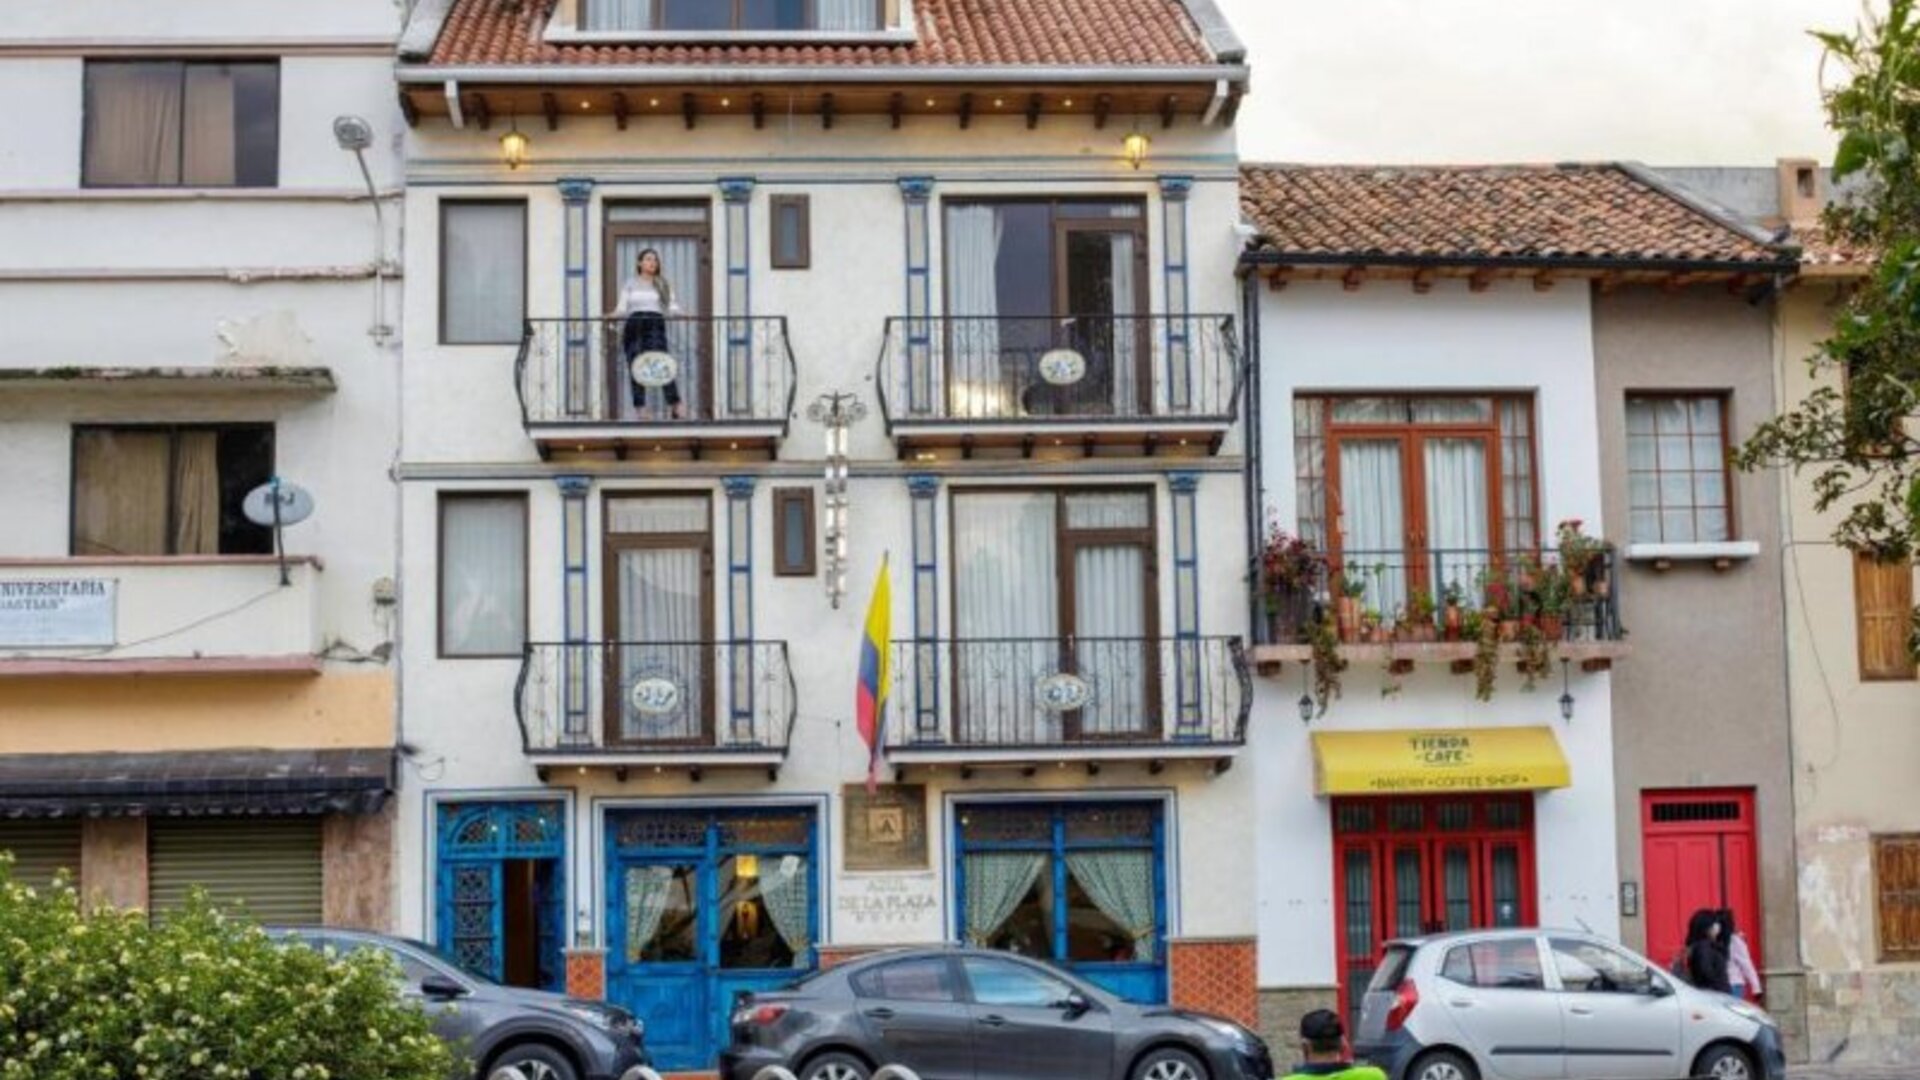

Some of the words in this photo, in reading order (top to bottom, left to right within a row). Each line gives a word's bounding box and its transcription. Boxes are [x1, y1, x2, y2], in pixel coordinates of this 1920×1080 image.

[1411, 736, 1470, 750] TIENDA
[1434, 775, 1481, 787] COFFEE
[1485, 774, 1521, 785] SHOP
[887, 894, 939, 910] PLAZA
